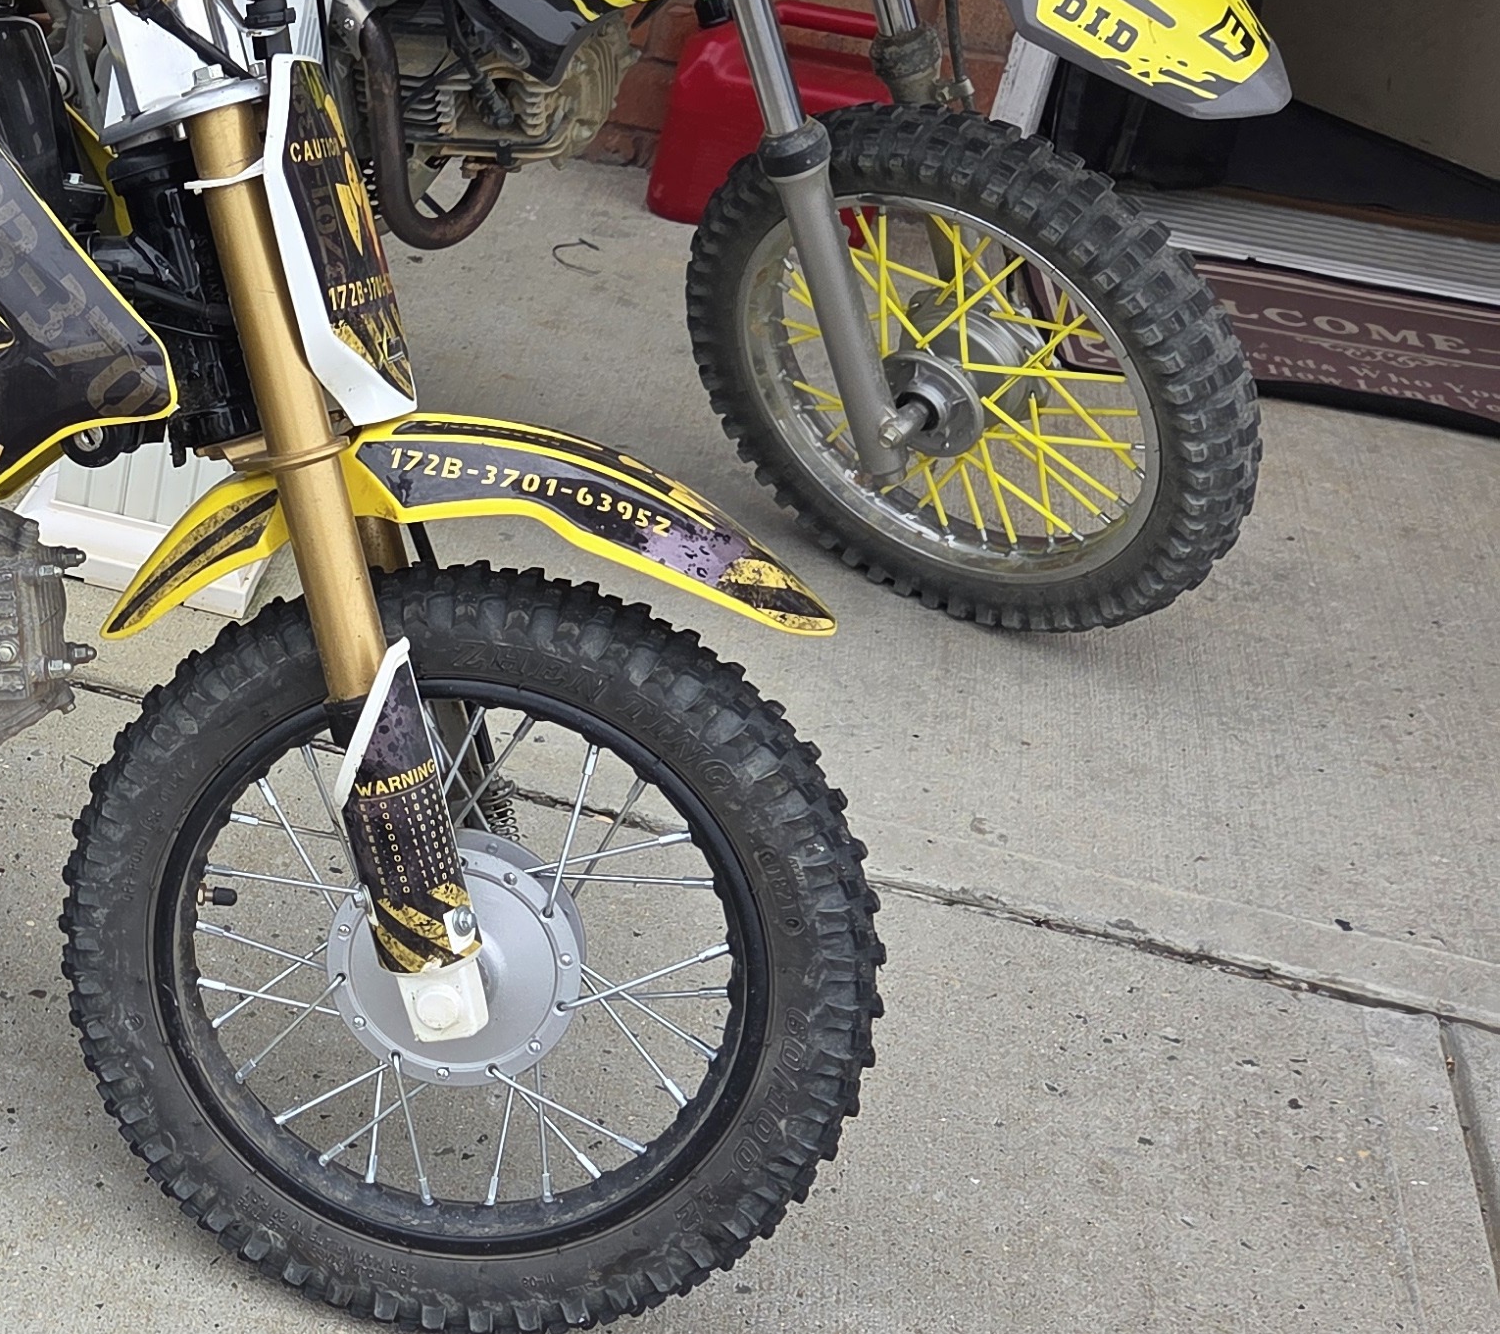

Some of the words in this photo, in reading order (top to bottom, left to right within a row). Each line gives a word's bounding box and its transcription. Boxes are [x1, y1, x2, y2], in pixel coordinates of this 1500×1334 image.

[1218, 297, 1473, 356] LCOME
[389, 447, 674, 538] 172B-3701-6395Z
[355, 757, 436, 798] WARNING
